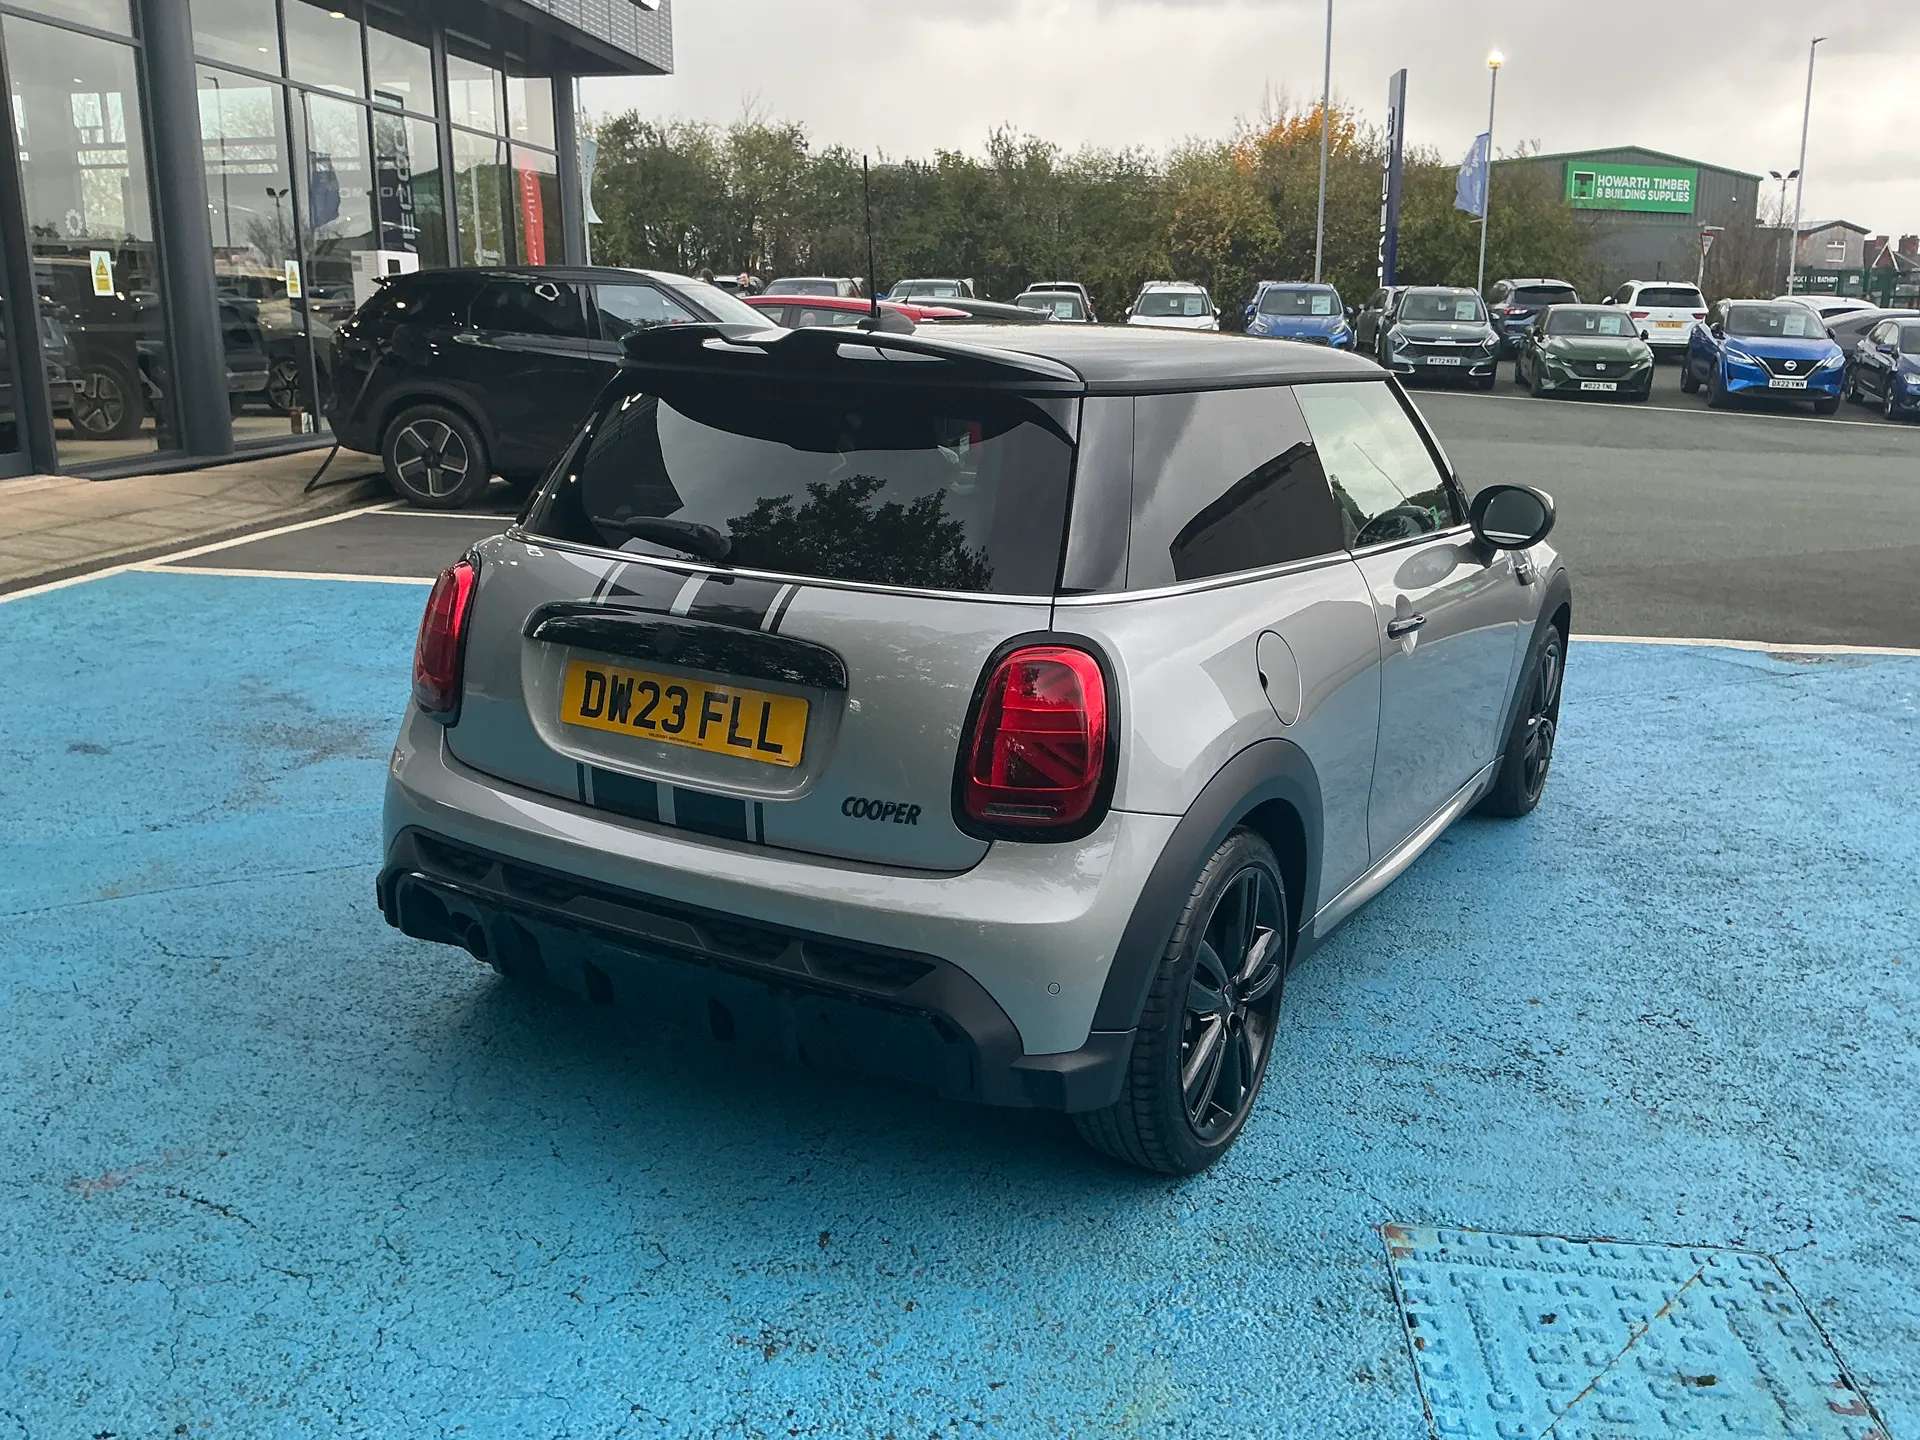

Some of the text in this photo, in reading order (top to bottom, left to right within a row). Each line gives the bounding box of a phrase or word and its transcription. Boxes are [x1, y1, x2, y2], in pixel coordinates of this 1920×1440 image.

[1597, 174, 1690, 191] HOWARTH TIMBER
[1604, 188, 1646, 200] BUILDING
[1647, 191, 1690, 202] SUPPLIES
[580, 670, 783, 754] DW23 FLL
[840, 796, 922, 826] COOPER
